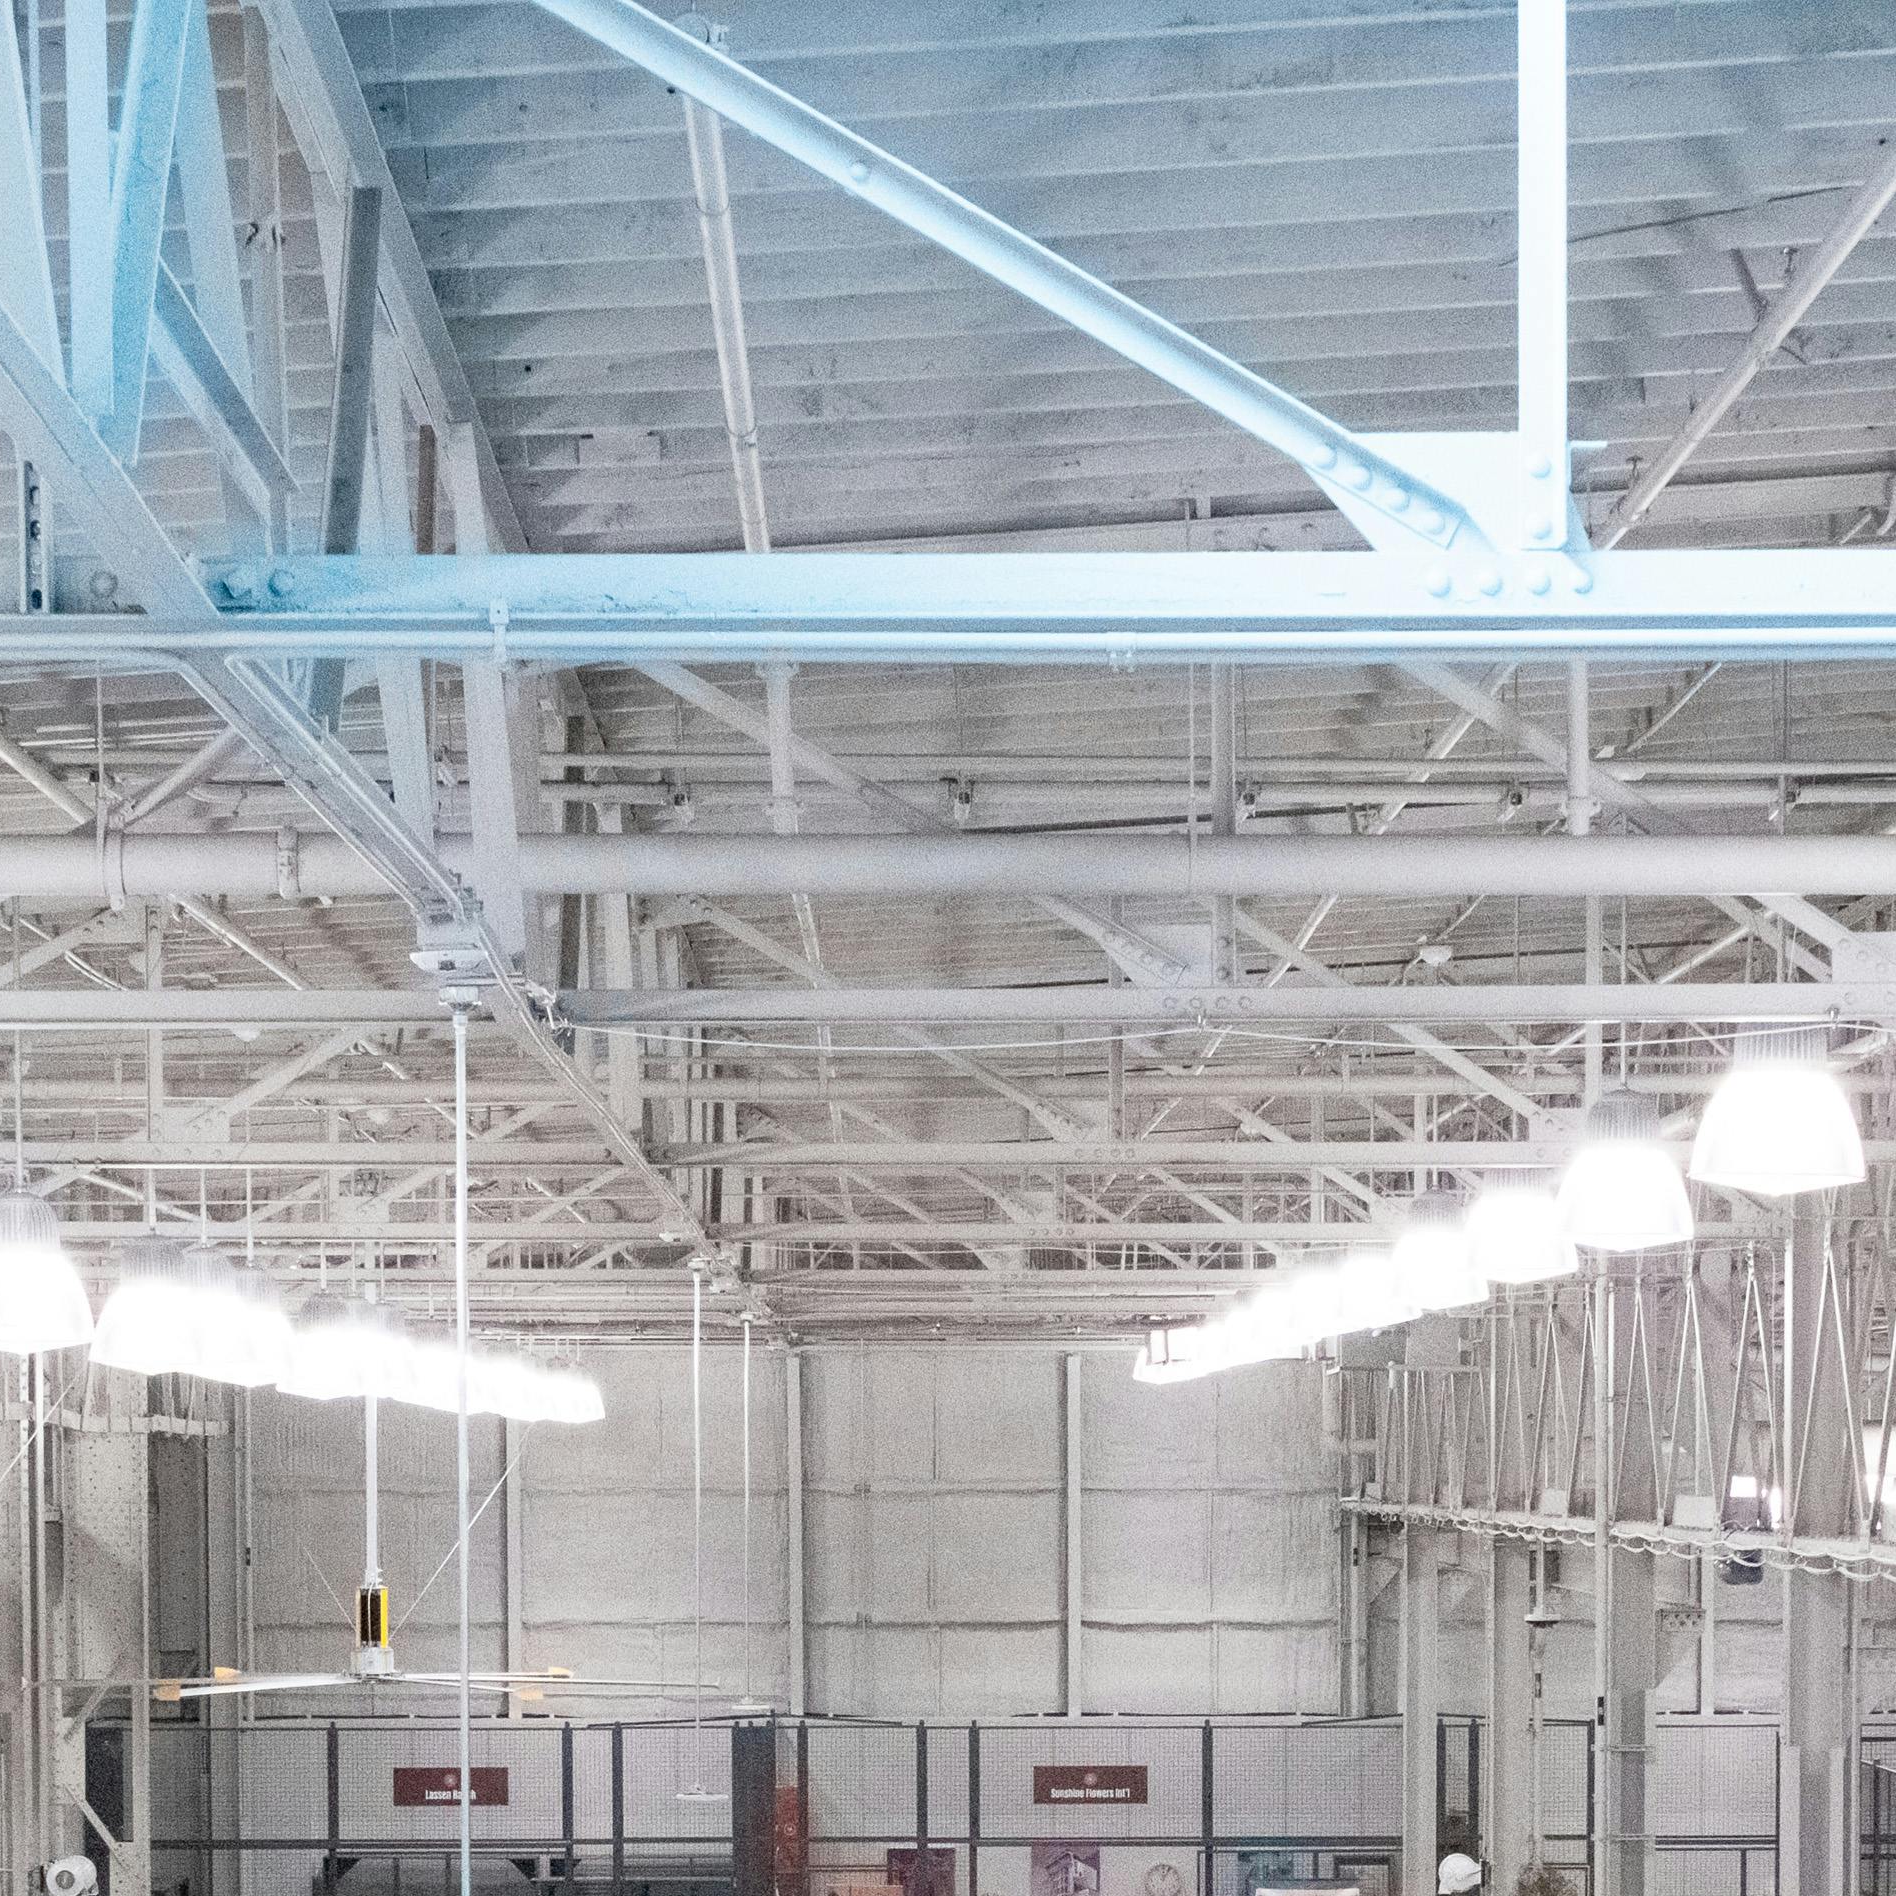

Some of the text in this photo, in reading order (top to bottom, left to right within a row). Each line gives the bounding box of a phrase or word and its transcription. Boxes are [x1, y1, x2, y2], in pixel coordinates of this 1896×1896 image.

[425, 1789, 477, 1800] Lassen Rah
[1050, 1788, 1084, 1798] Sunshine
[1085, 1788, 1114, 1798] Flowers
